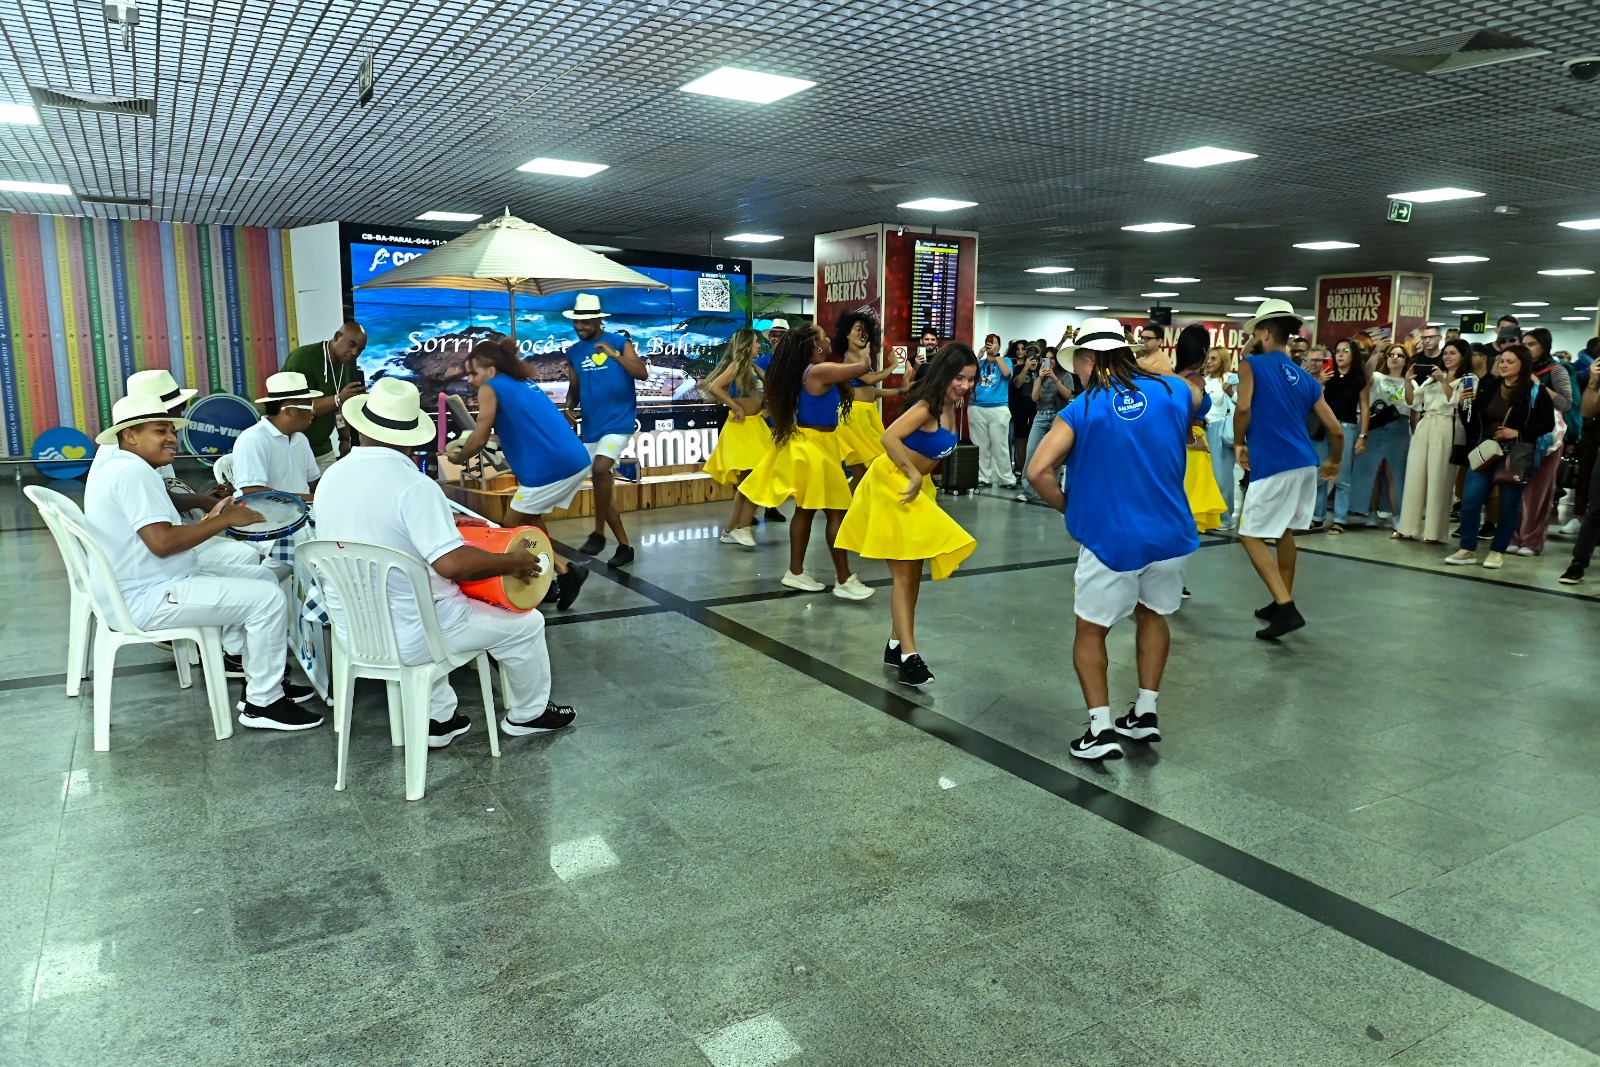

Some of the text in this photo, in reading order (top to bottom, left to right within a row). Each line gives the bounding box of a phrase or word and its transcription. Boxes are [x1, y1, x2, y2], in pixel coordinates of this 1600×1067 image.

[824, 260, 869, 285] BRAHMAS
[826, 280, 867, 302] ABERTAS
[1363, 285, 1371, 293] TÁ
[1327, 293, 1381, 309] BRAHMAS
[1328, 307, 1378, 322] ABERTAS
[1209, 323, 1225, 350] TÁ
[1228, 329, 1246, 349] DE
[1473, 322, 1484, 332] 01
[405, 331, 489, 353] Sorri
